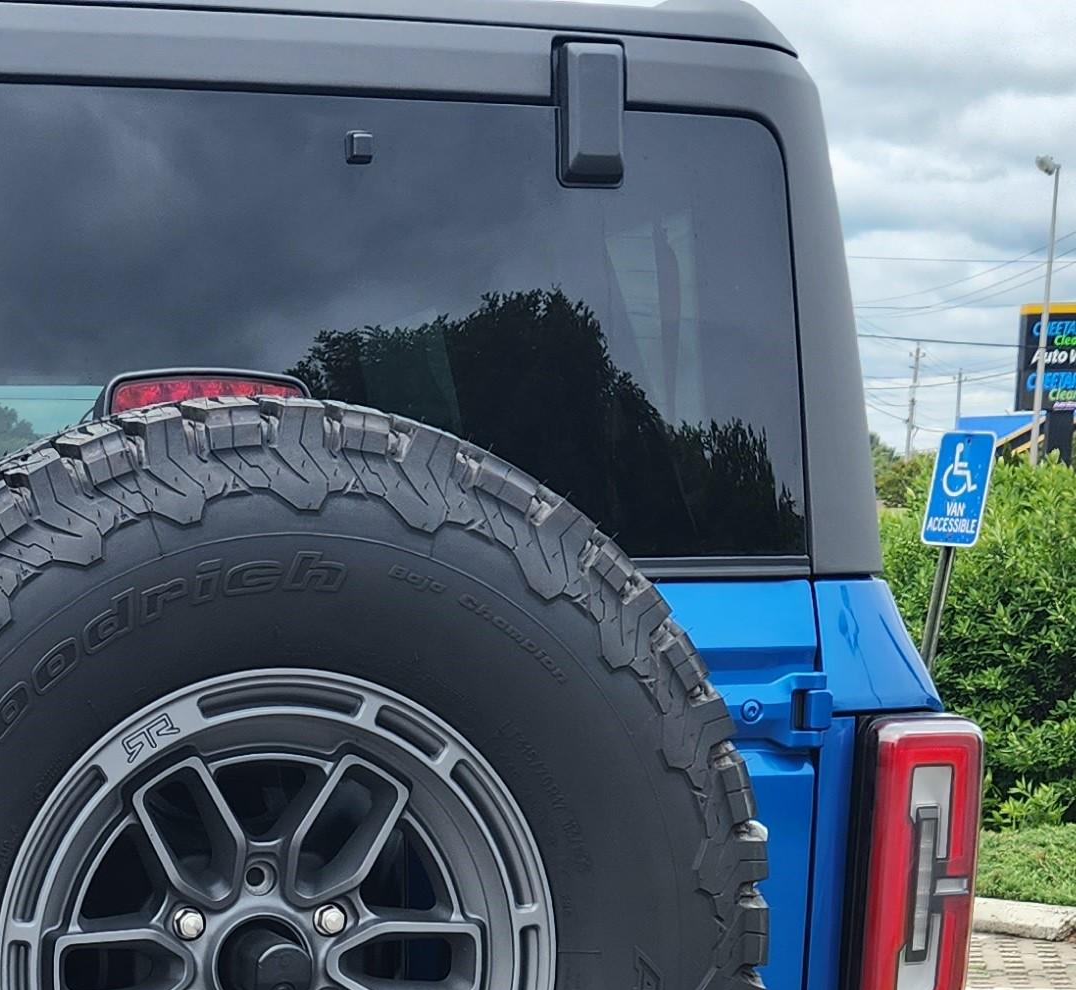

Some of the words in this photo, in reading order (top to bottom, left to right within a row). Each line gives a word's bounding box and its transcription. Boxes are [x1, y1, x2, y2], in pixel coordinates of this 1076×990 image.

[1032, 321, 1076, 337] CEETA
[946, 501, 965, 515] VAN
[926, 517, 977, 535] ACCESSIBLE
[388, 564, 447, 593] Baja
[458, 593, 567, 684] Champion
